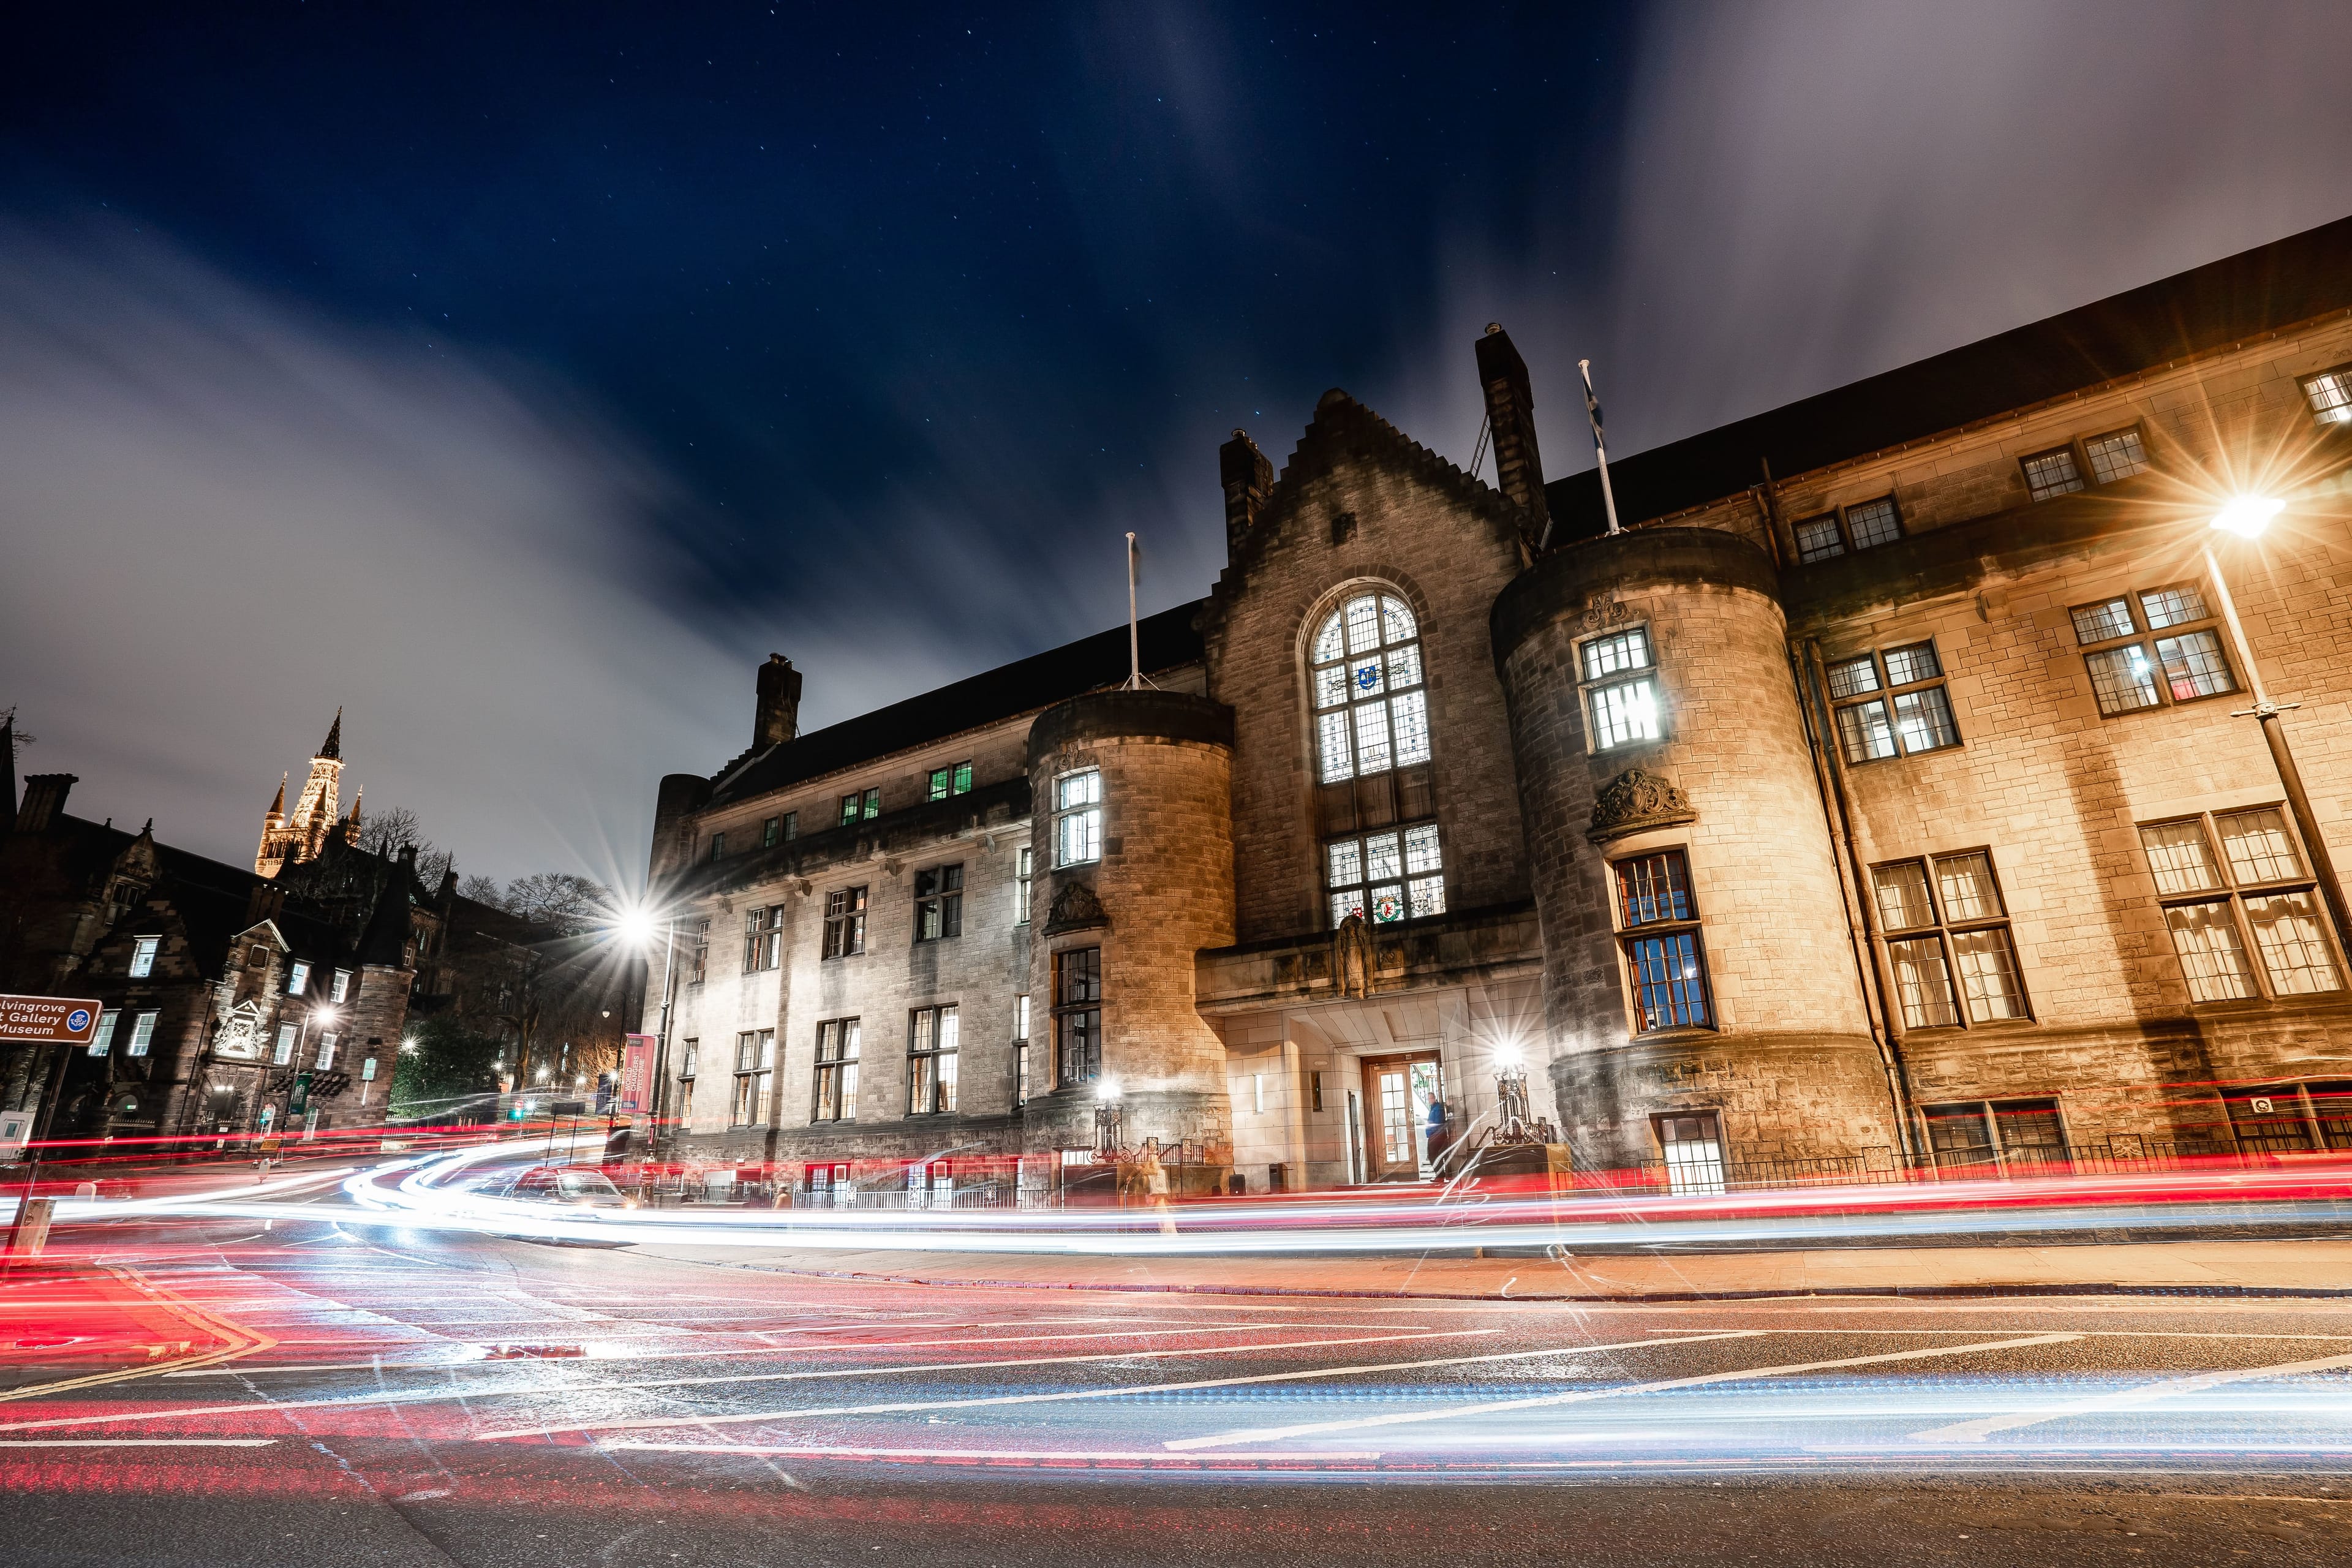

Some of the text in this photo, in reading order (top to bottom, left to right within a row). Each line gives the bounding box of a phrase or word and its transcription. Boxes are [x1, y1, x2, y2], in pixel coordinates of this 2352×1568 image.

[0, 1000, 66, 1012] lvingrove
[9, 1012, 61, 1025] Gallery
[0, 1023, 54, 1035] Museum
[631, 1055, 639, 1091] CHANGERS
[636, 1058, 645, 1091] WELCOME
